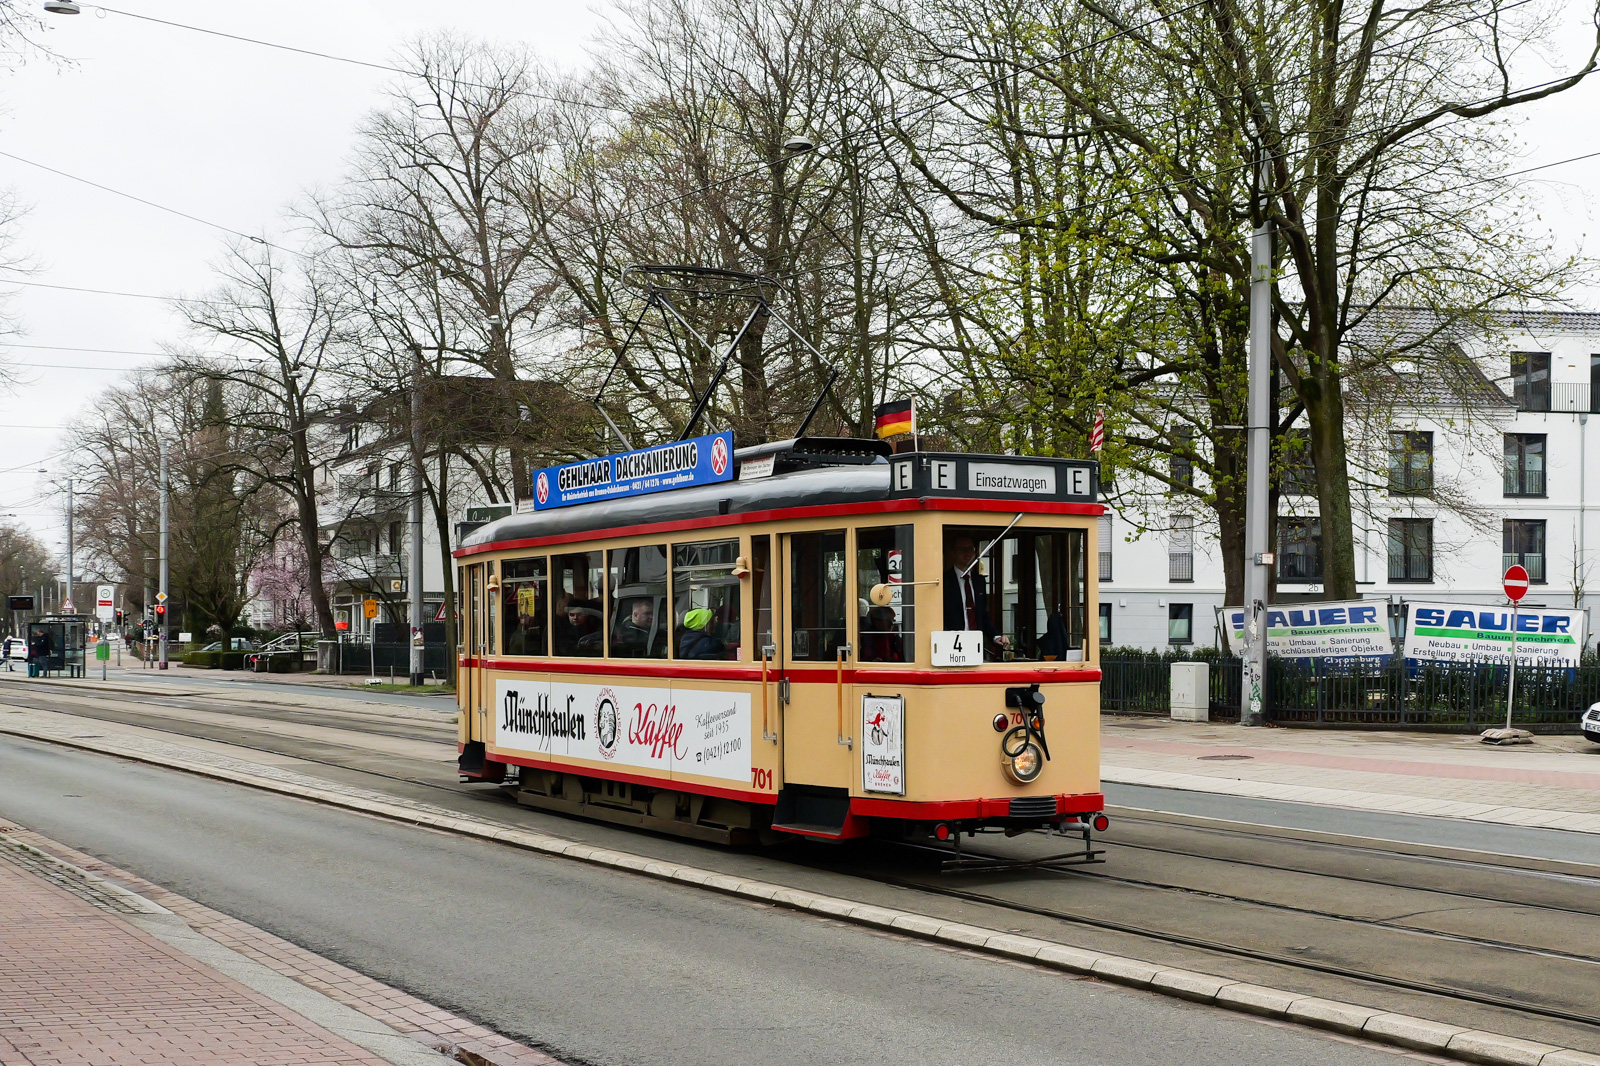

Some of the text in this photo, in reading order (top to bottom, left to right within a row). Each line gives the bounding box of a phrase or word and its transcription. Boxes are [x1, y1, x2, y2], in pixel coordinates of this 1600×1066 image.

[558, 442, 698, 491] GEHLHAAR DACHSANIERUNG
[662, 471, 694, 486] www.gehlhaar.de
[899, 464, 1083, 494] E E Einsatzwagen E
[1415, 608, 1570, 633] SAUER
[1291, 626, 1380, 636] Bauunternehmen
[953, 634, 963, 653] 4
[1288, 639, 1316, 647] Umbau
[1330, 637, 1370, 645] Sanierung
[1428, 640, 1559, 656] Neubau Umbau Sanierung
[1281, 646, 1347, 655] schlüsselfertiger
[1351, 645, 1383, 653] Objekte
[1413, 647, 1457, 659] Erstellung
[949, 653, 966, 663] Horn
[695, 701, 736, 730] Kaffeeversand
[1010, 712, 1028, 724] 70
[502, 690, 688, 760] Münchhausen Kaffee
[704, 727, 714, 739] seit
[751, 767, 772, 790] 701
